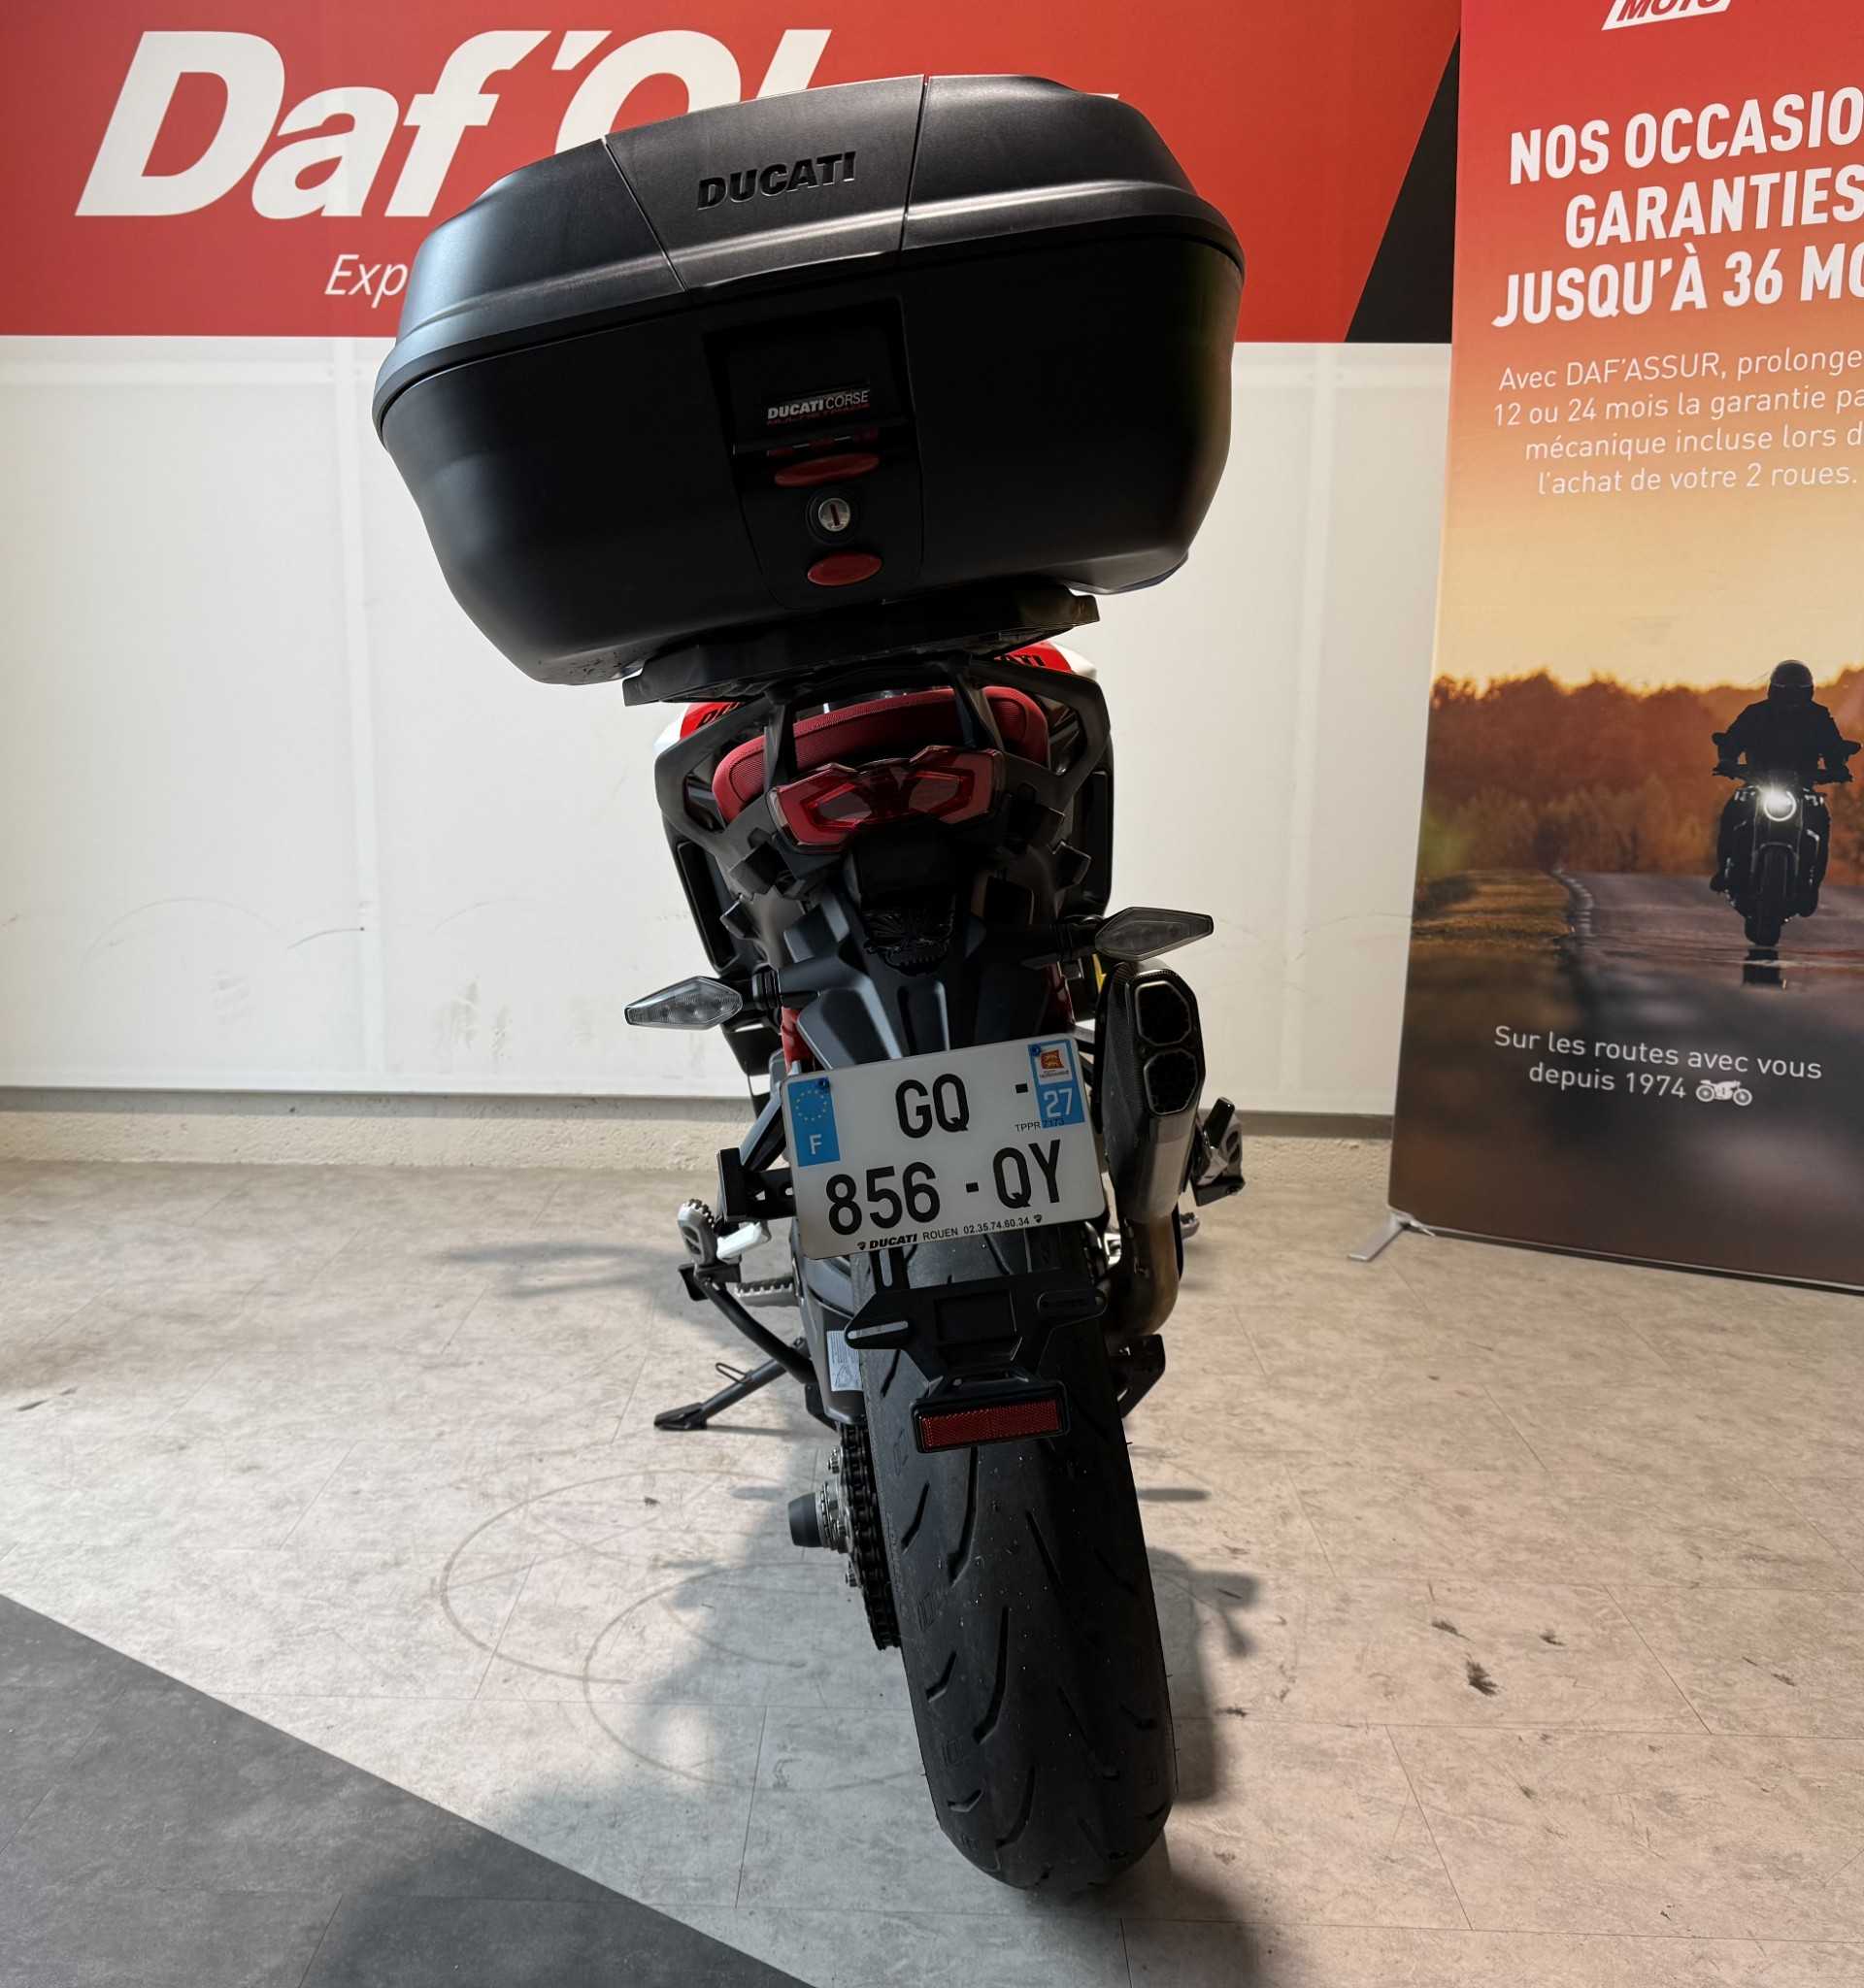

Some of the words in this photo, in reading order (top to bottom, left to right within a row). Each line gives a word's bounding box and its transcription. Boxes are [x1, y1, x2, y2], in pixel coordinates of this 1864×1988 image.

[1510, 119, 1610, 184] NOS
[1624, 86, 1864, 169] OCCASIO
[697, 151, 856, 210] DUCATI
[1565, 164, 1864, 248] GARANTIES
[1491, 243, 1708, 327] JUSQU'À
[1722, 248, 1783, 308] 36
[1499, 368, 1557, 390] Avec
[1566, 352, 1726, 386] DAF'ASSUR,
[1737, 348, 1864, 381] prolonge
[1493, 403, 1521, 426] 12
[1529, 408, 1557, 425] ou
[1568, 397, 1596, 422] 24
[1605, 394, 1669, 420] mois
[1677, 392, 1700, 415] la
[1711, 384, 1826, 420] garantie
[1525, 433, 1667, 461] mécanique
[1676, 428, 1773, 452] incluse
[1782, 424, 1836, 448] lors
[1538, 470, 1623, 495] l'achat
[1630, 468, 1662, 491] de
[1670, 467, 1738, 490] votre
[1747, 463, 1762, 487] 2
[1771, 465, 1857, 487] roues.
[1493, 1025, 1541, 1050] Sur
[1548, 1031, 1585, 1055] les
[1594, 1042, 1680, 1066] routes
[1687, 1052, 1748, 1073] avec
[1756, 1059, 1822, 1080] vous
[1529, 1062, 1615, 1092] depuis
[1624, 1073, 1686, 1098] 1974
[895, 1073, 970, 1139] GQ
[1043, 1088, 1073, 1118] 27
[809, 1134, 822, 1155] F
[1015, 1121, 1041, 1133] TPPR
[825, 1162, 941, 1235] 856
[992, 1139, 1061, 1209] QY
[869, 1234, 918, 1249] DUCATI
[922, 1229, 958, 1241] ROUEN
